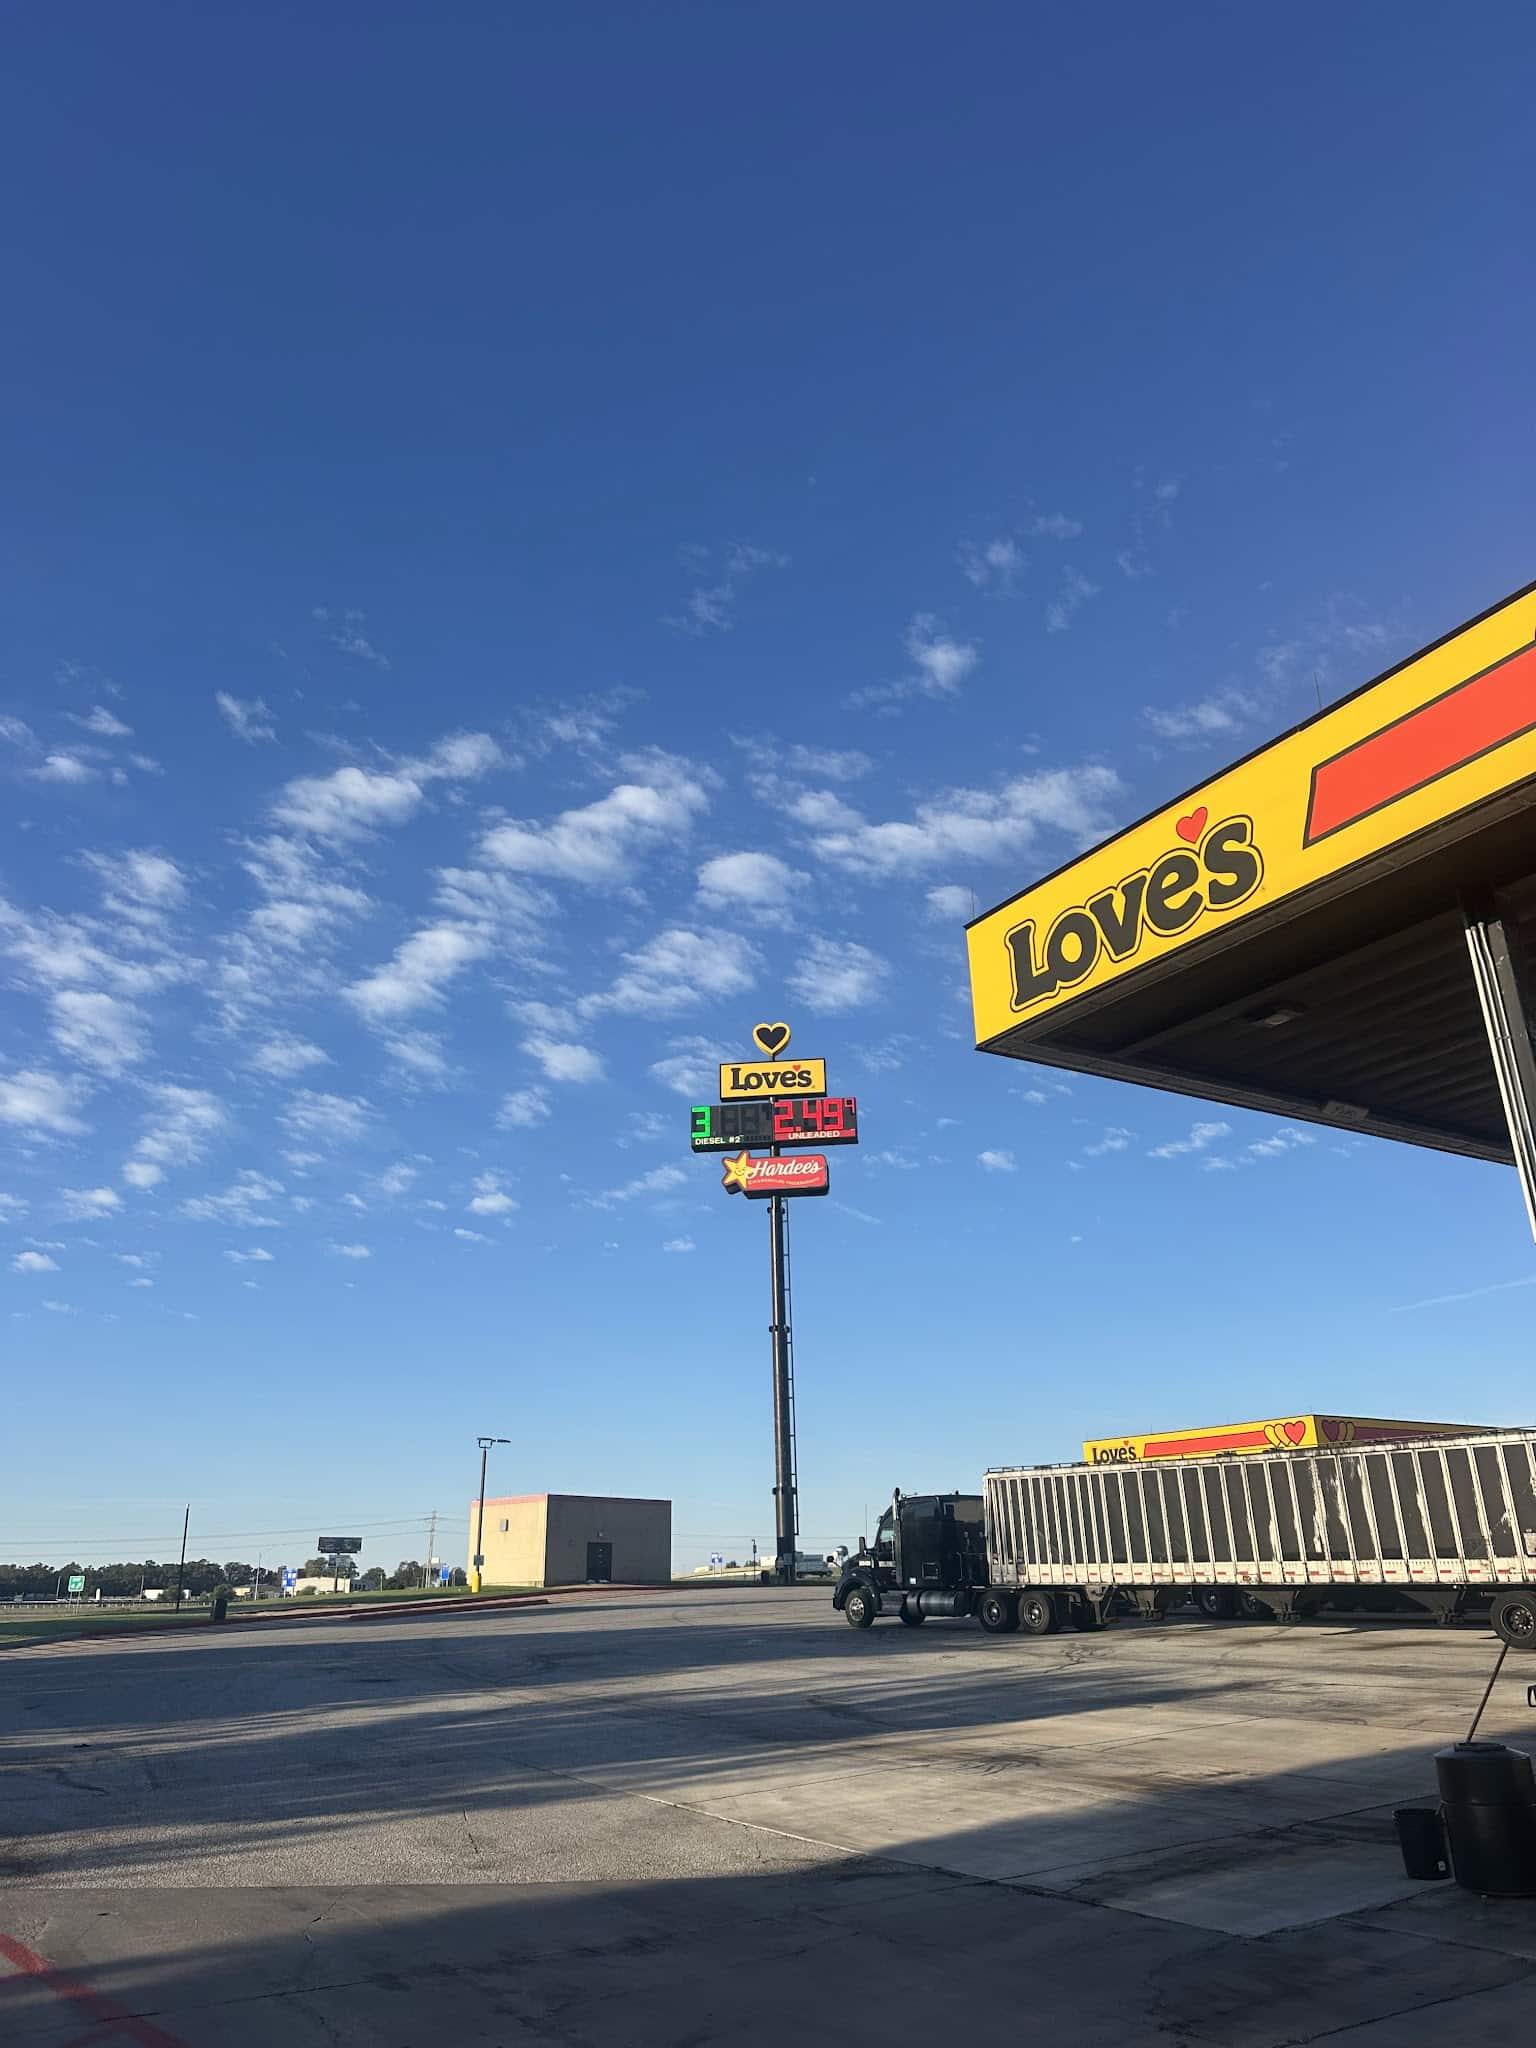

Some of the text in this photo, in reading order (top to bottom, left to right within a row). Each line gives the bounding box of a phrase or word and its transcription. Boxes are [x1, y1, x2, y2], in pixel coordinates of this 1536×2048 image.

[788, 1130, 840, 1140] UNLEADED
[695, 1136, 726, 1145] DIESEL
[746, 1159, 824, 1179] Hardee's
